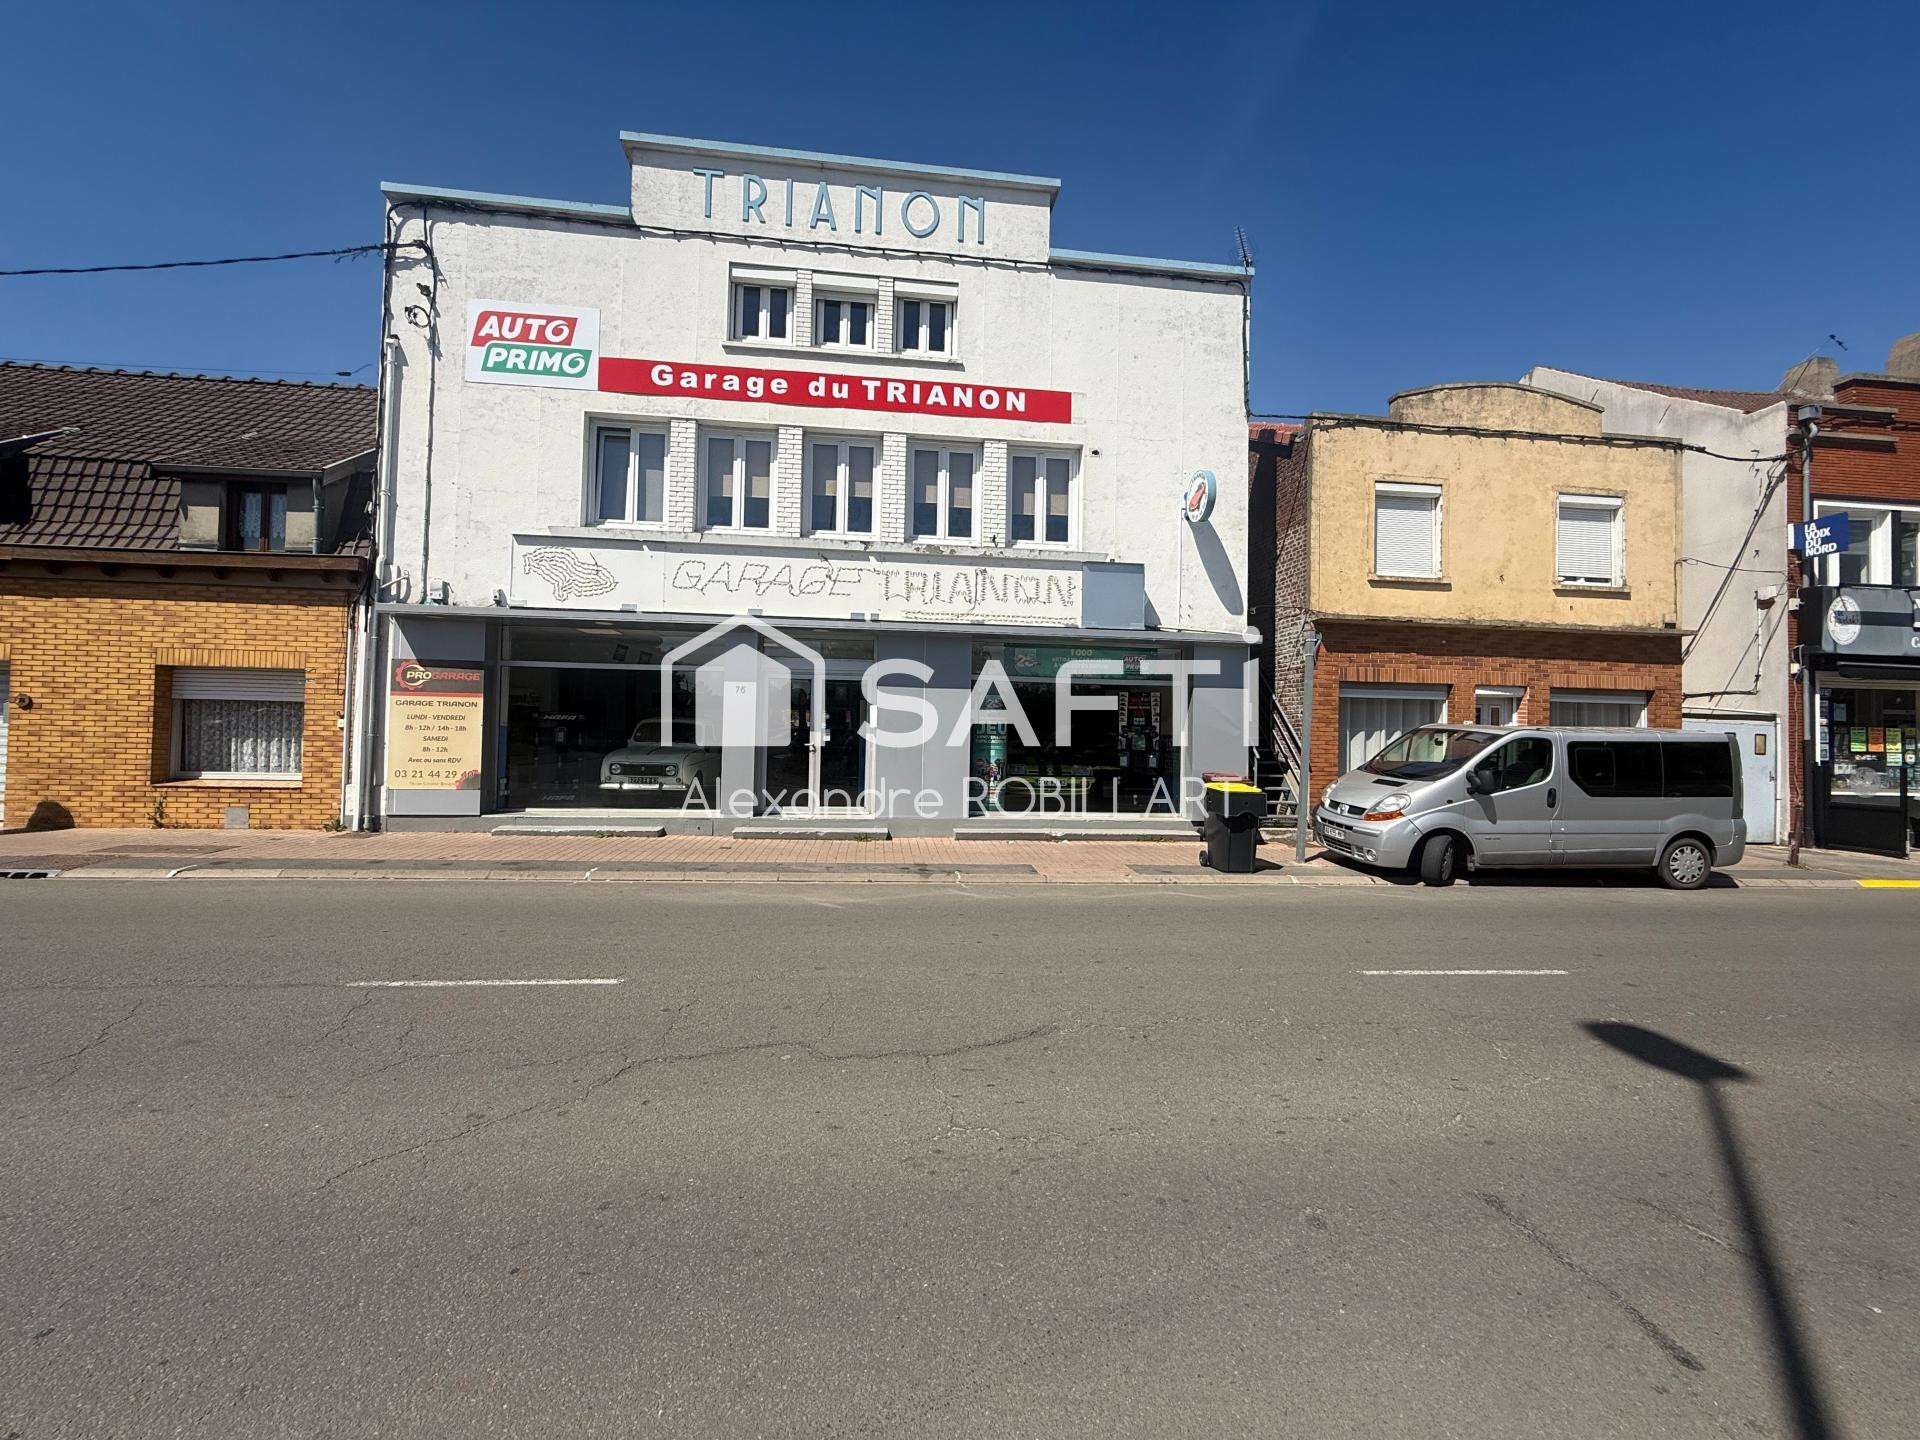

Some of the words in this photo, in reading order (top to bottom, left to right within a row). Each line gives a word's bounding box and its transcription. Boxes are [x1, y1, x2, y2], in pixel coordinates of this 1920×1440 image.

[693, 168, 985, 245] TRIANON
[478, 314, 570, 343] AUTO
[486, 347, 586, 374] PRIMO
[651, 363, 789, 399] Garage
[808, 376, 849, 399] du
[861, 379, 1026, 412] TRIANON
[1804, 522, 1817, 533] LA
[1805, 527, 1832, 540] VOIX
[1805, 538, 1822, 549] DU
[1806, 543, 1838, 557] NORD
[672, 559, 863, 598] GARAGE
[395, 699, 434, 708] GARAGE
[437, 700, 478, 708] TRIANON
[406, 713, 428, 721] LUNDI
[432, 713, 466, 721] VENDREDI
[394, 769, 408, 778] 03
[411, 770, 424, 779] 21
[427, 770, 441, 779] 44
[444, 770, 458, 779] 29
